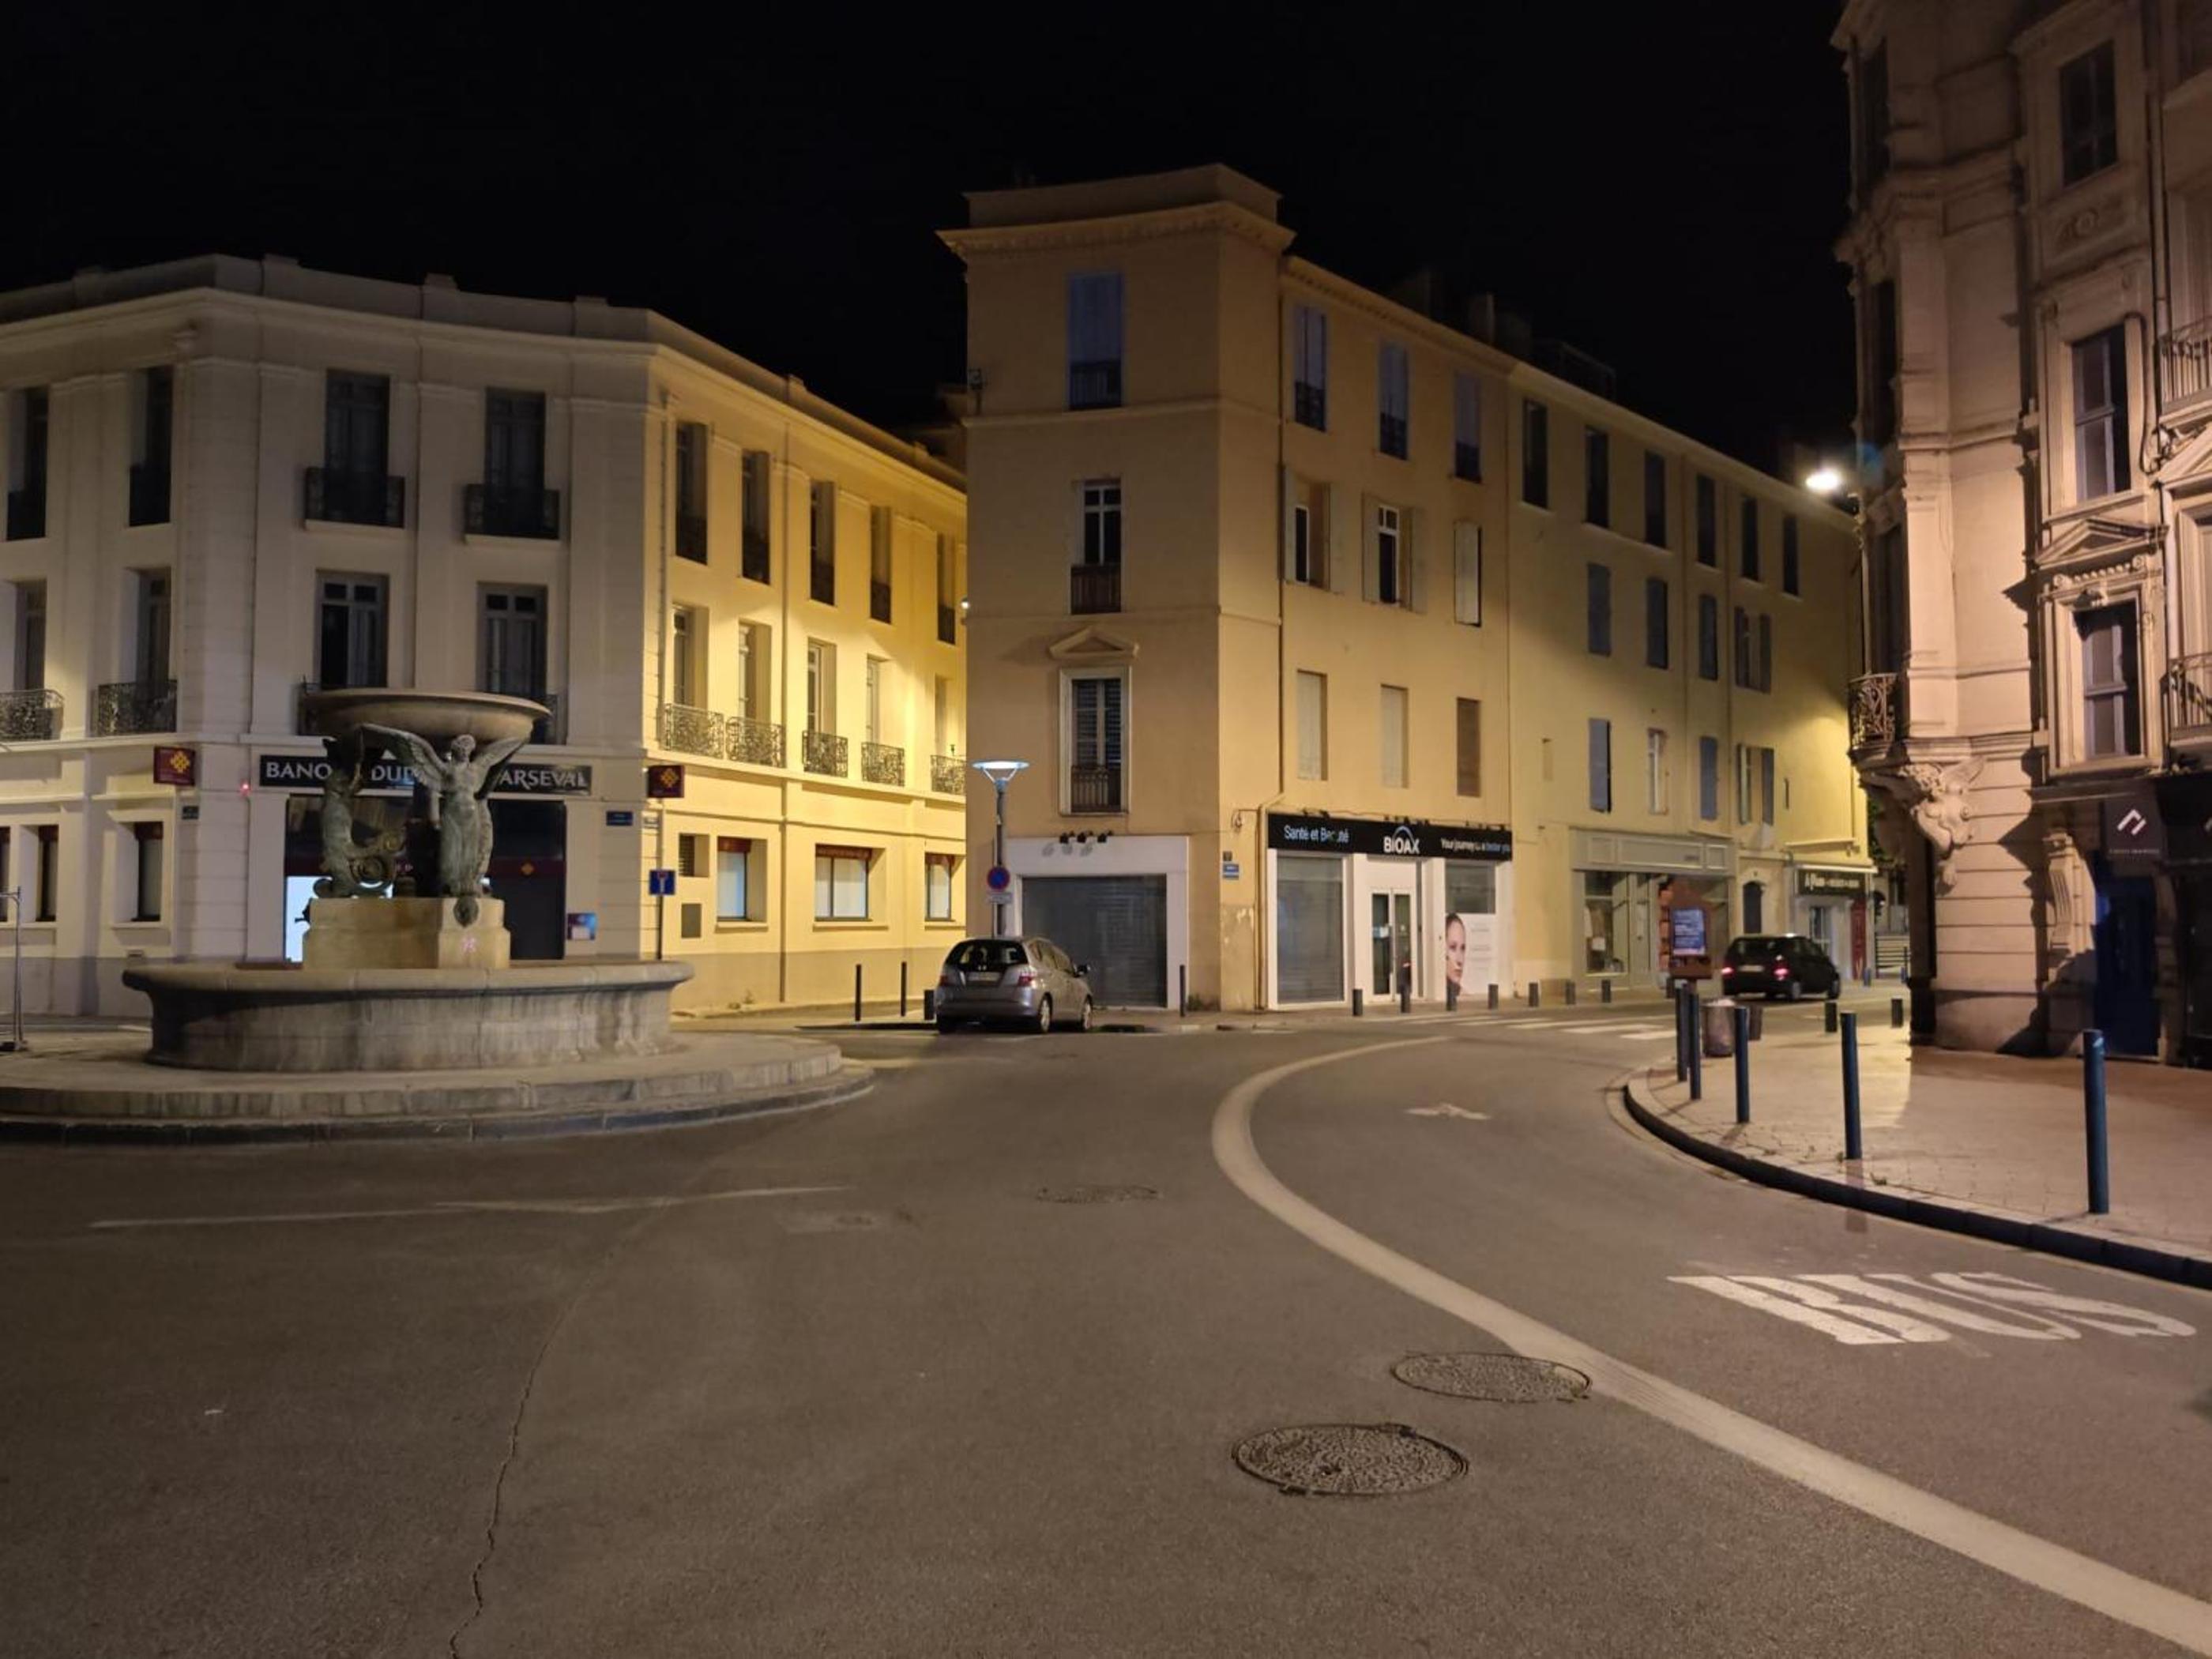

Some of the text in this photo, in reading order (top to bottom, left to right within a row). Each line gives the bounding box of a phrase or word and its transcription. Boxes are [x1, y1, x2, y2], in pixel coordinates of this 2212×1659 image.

[498, 769, 589, 790] ARSEVAL
[1283, 824, 1309, 841] Santé
[1310, 828, 1319, 842] et
[1383, 836, 1420, 854] BIOAX
[1667, 1273, 2197, 1345] BUS
